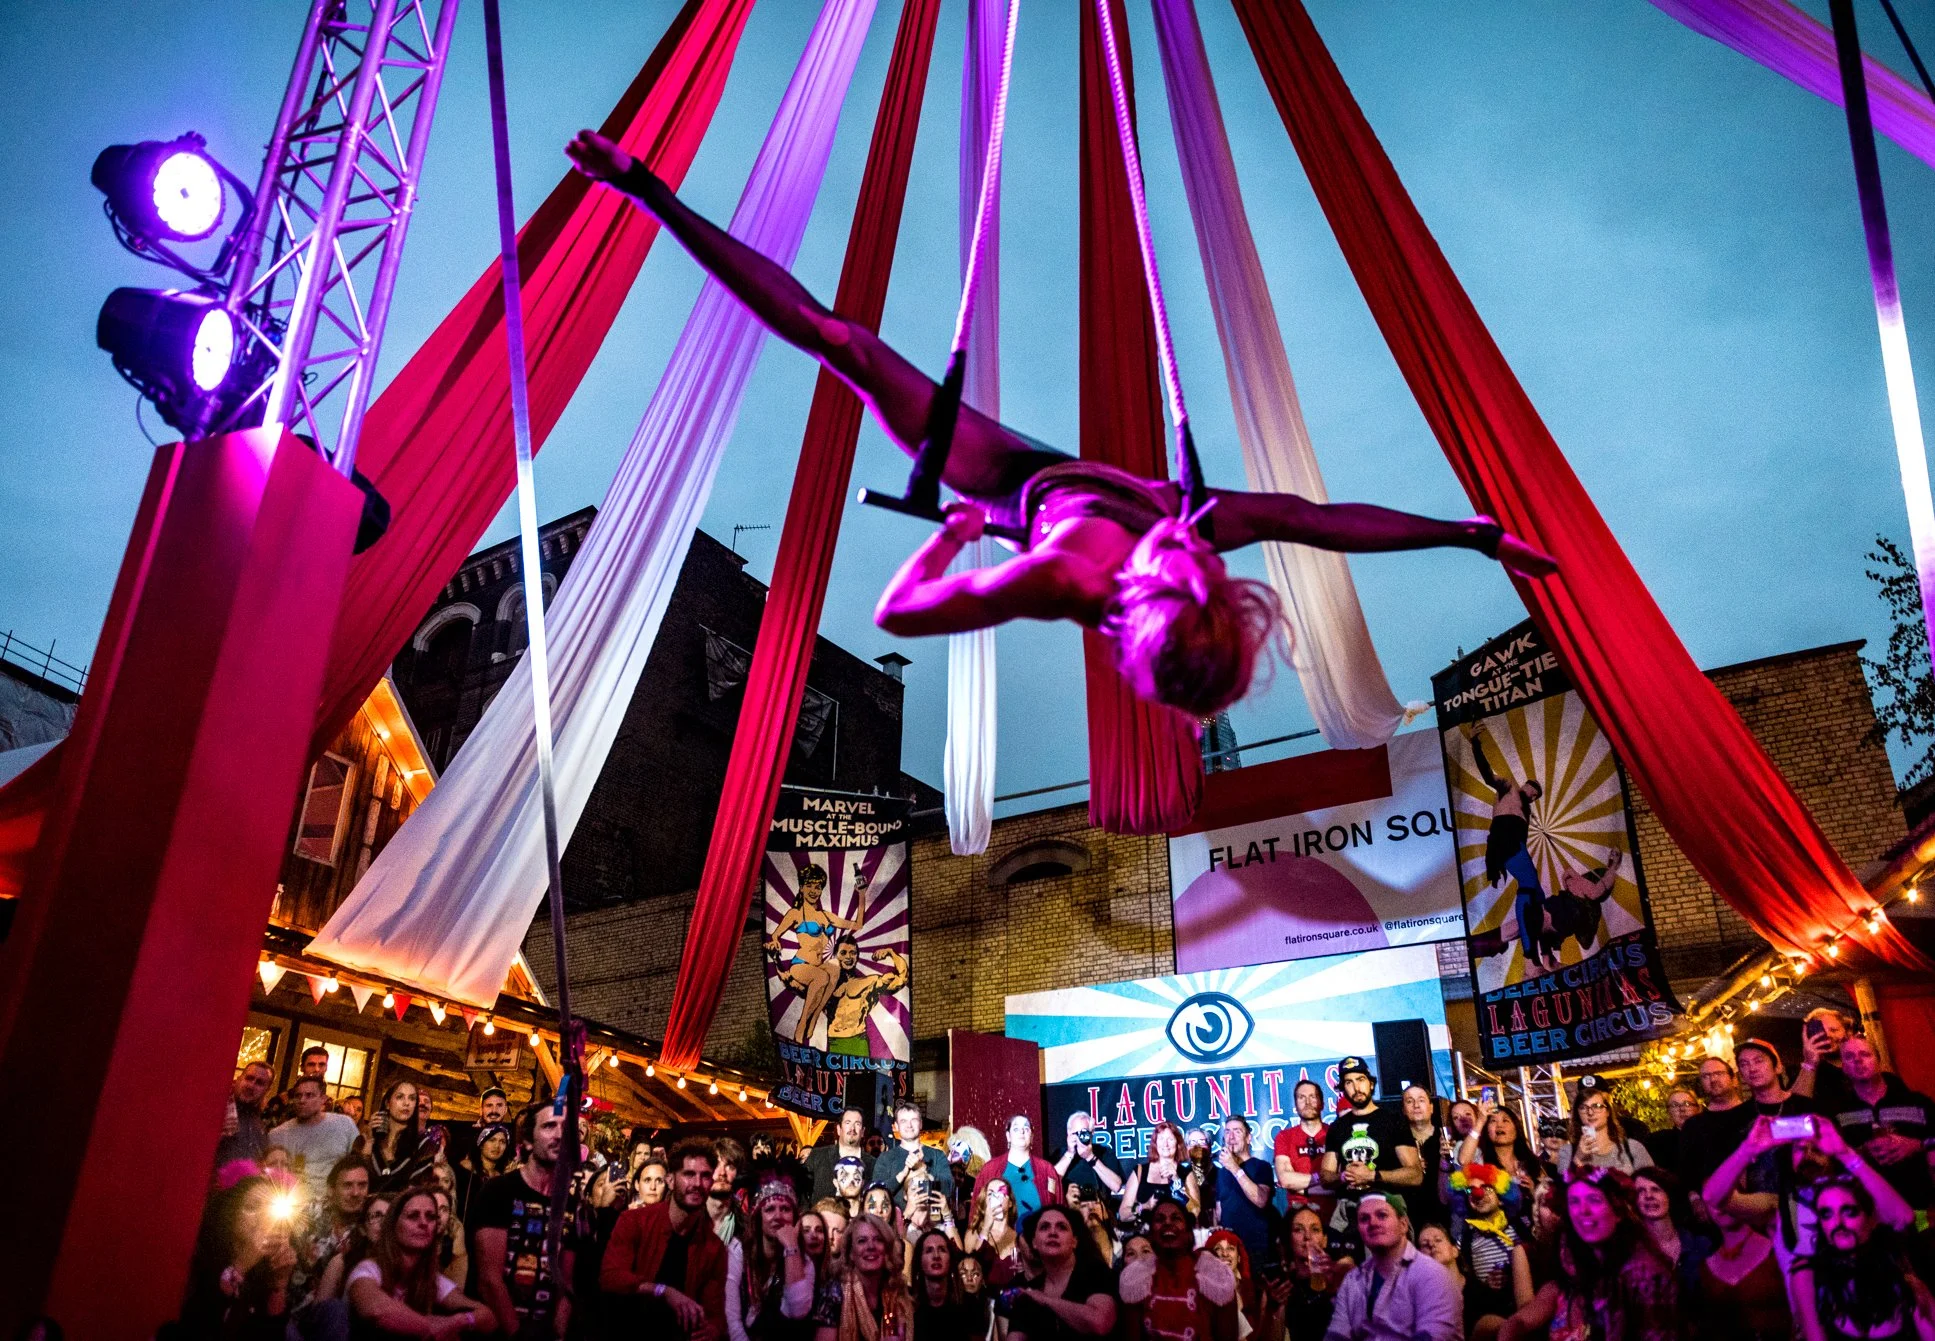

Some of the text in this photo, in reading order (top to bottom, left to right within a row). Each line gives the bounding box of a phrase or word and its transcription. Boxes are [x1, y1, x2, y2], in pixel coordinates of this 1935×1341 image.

[1470, 631, 1537, 677] GAWK
[1492, 658, 1519, 677] AT THE
[1479, 677, 1543, 712] TITAN
[803, 797, 875, 815] MARVEL
[796, 834, 879, 848] MAXIMUS
[1209, 837, 1280, 872] FLAT
[1293, 820, 1373, 858] IRON
[1285, 912, 1464, 945] flatironsquare.co.uk @flatironsquare
[1491, 1001, 1673, 1059] BEER CIRCUS
[779, 1041, 821, 1068] BEER
[777, 1084, 824, 1113] BEER
[1088, 1064, 1340, 1129] LAGUNITS
[1092, 1125, 1185, 1159] BEE
